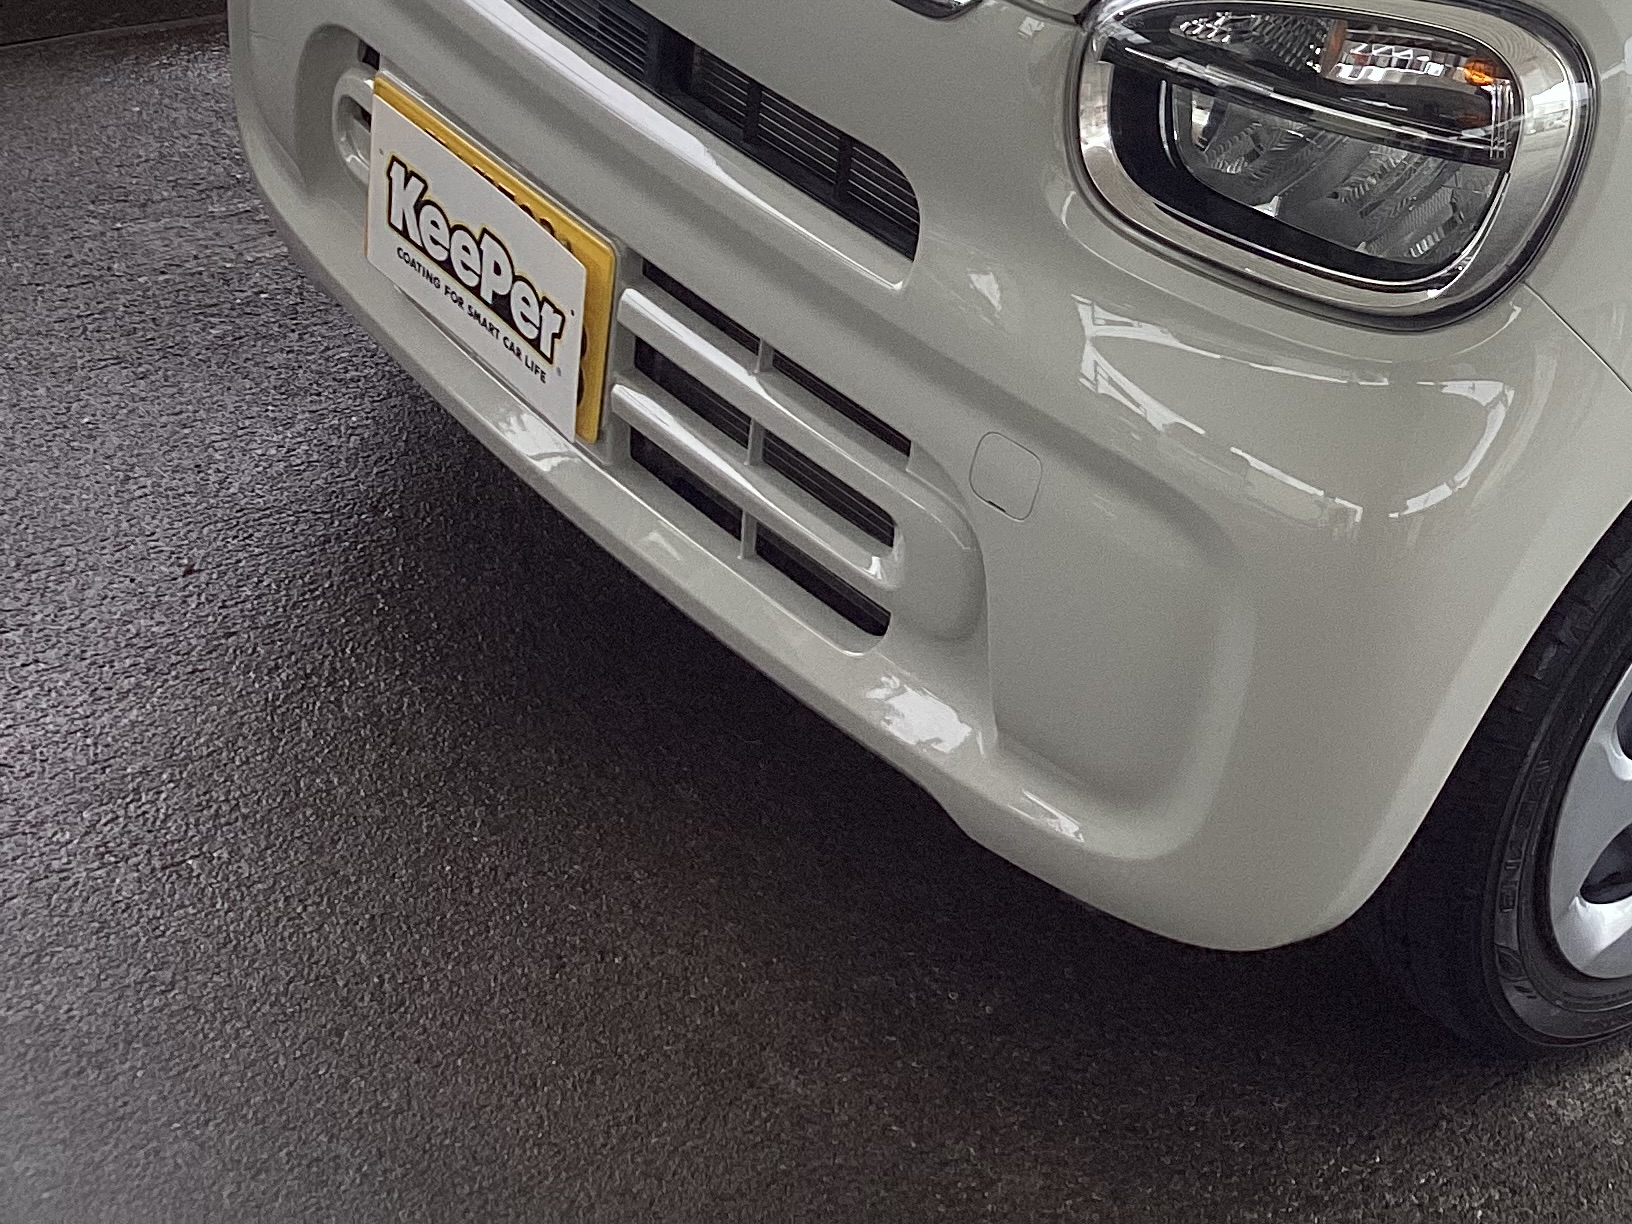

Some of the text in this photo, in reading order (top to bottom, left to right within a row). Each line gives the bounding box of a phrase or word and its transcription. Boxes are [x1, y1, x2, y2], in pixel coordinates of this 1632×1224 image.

[386, 154, 566, 364] KeePer
[396, 246, 548, 384] COATING FOR SMART CAR LIFE
